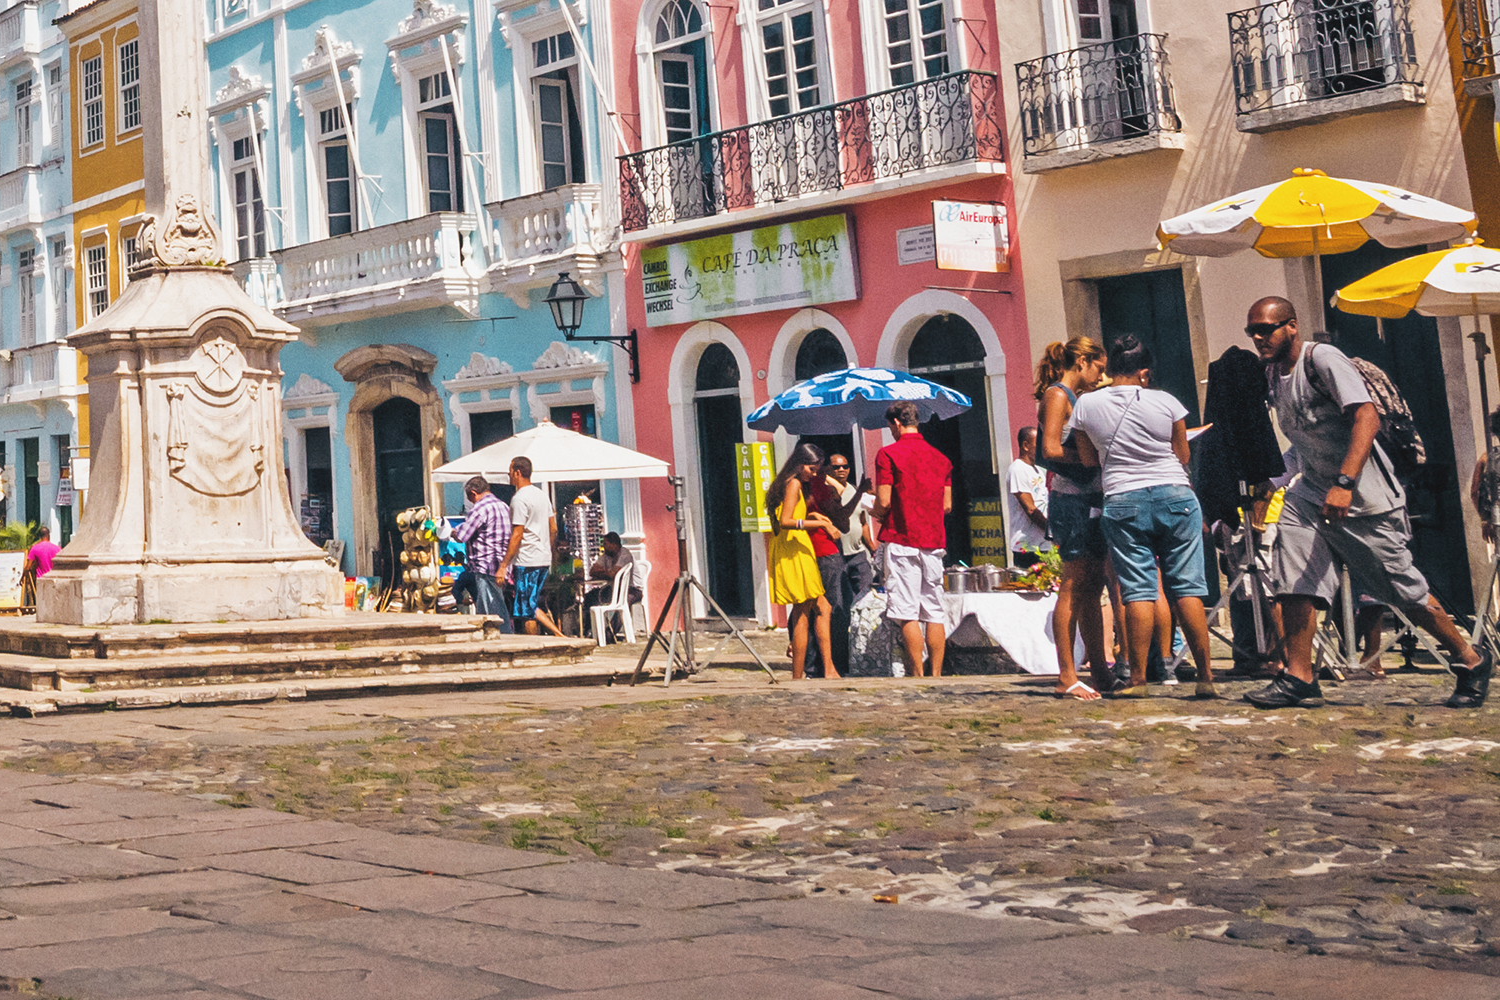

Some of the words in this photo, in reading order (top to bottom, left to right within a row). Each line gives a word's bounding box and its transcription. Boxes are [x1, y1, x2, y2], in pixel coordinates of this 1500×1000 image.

[702, 248, 742, 273] CAFÉ
[746, 246, 772, 266] DA
[776, 234, 839, 261] PRAÇA
[645, 278, 677, 294] EXCHANGE
[646, 299, 674, 313] WECHSEL
